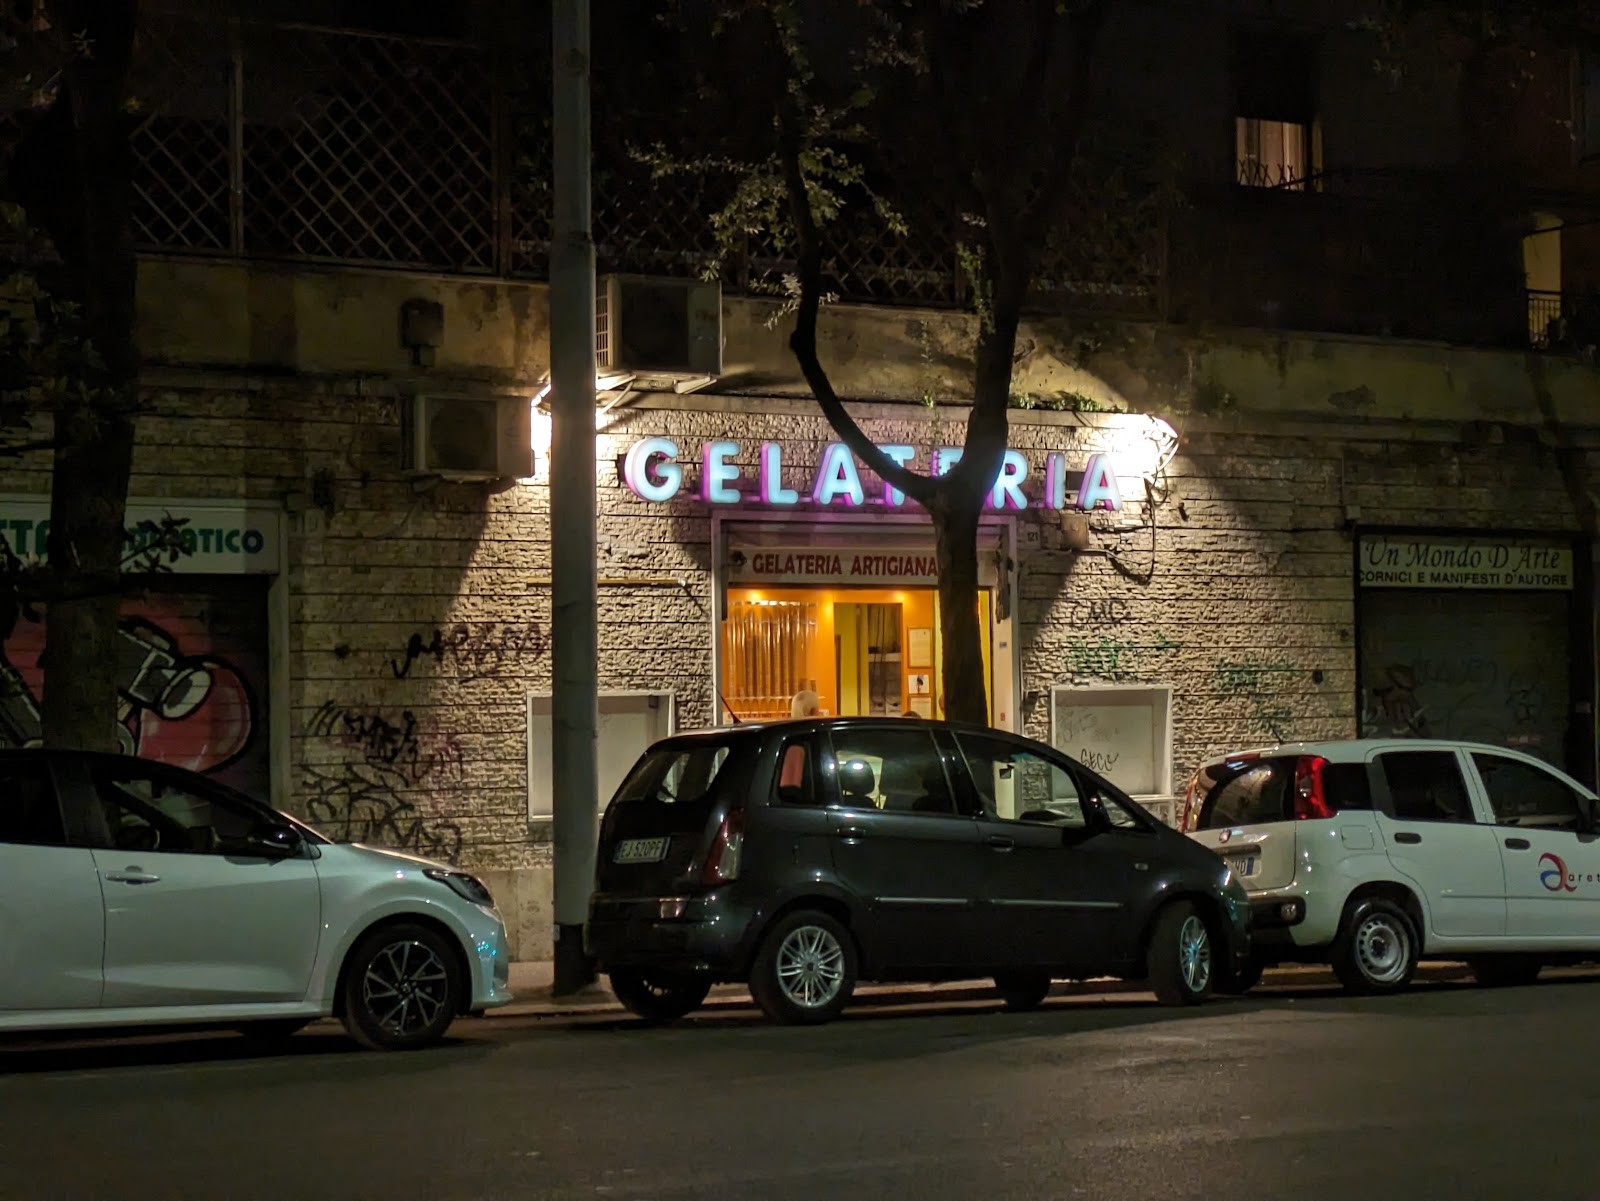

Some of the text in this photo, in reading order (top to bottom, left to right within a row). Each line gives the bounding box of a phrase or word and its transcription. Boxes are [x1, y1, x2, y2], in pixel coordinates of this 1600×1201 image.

[1365, 537, 1399, 566] Un
[1406, 541, 1482, 568] Mondo
[752, 553, 842, 575] GELATERIA
[1358, 570, 1568, 586] CORNICI E MANIFESTI D'AUTORE
